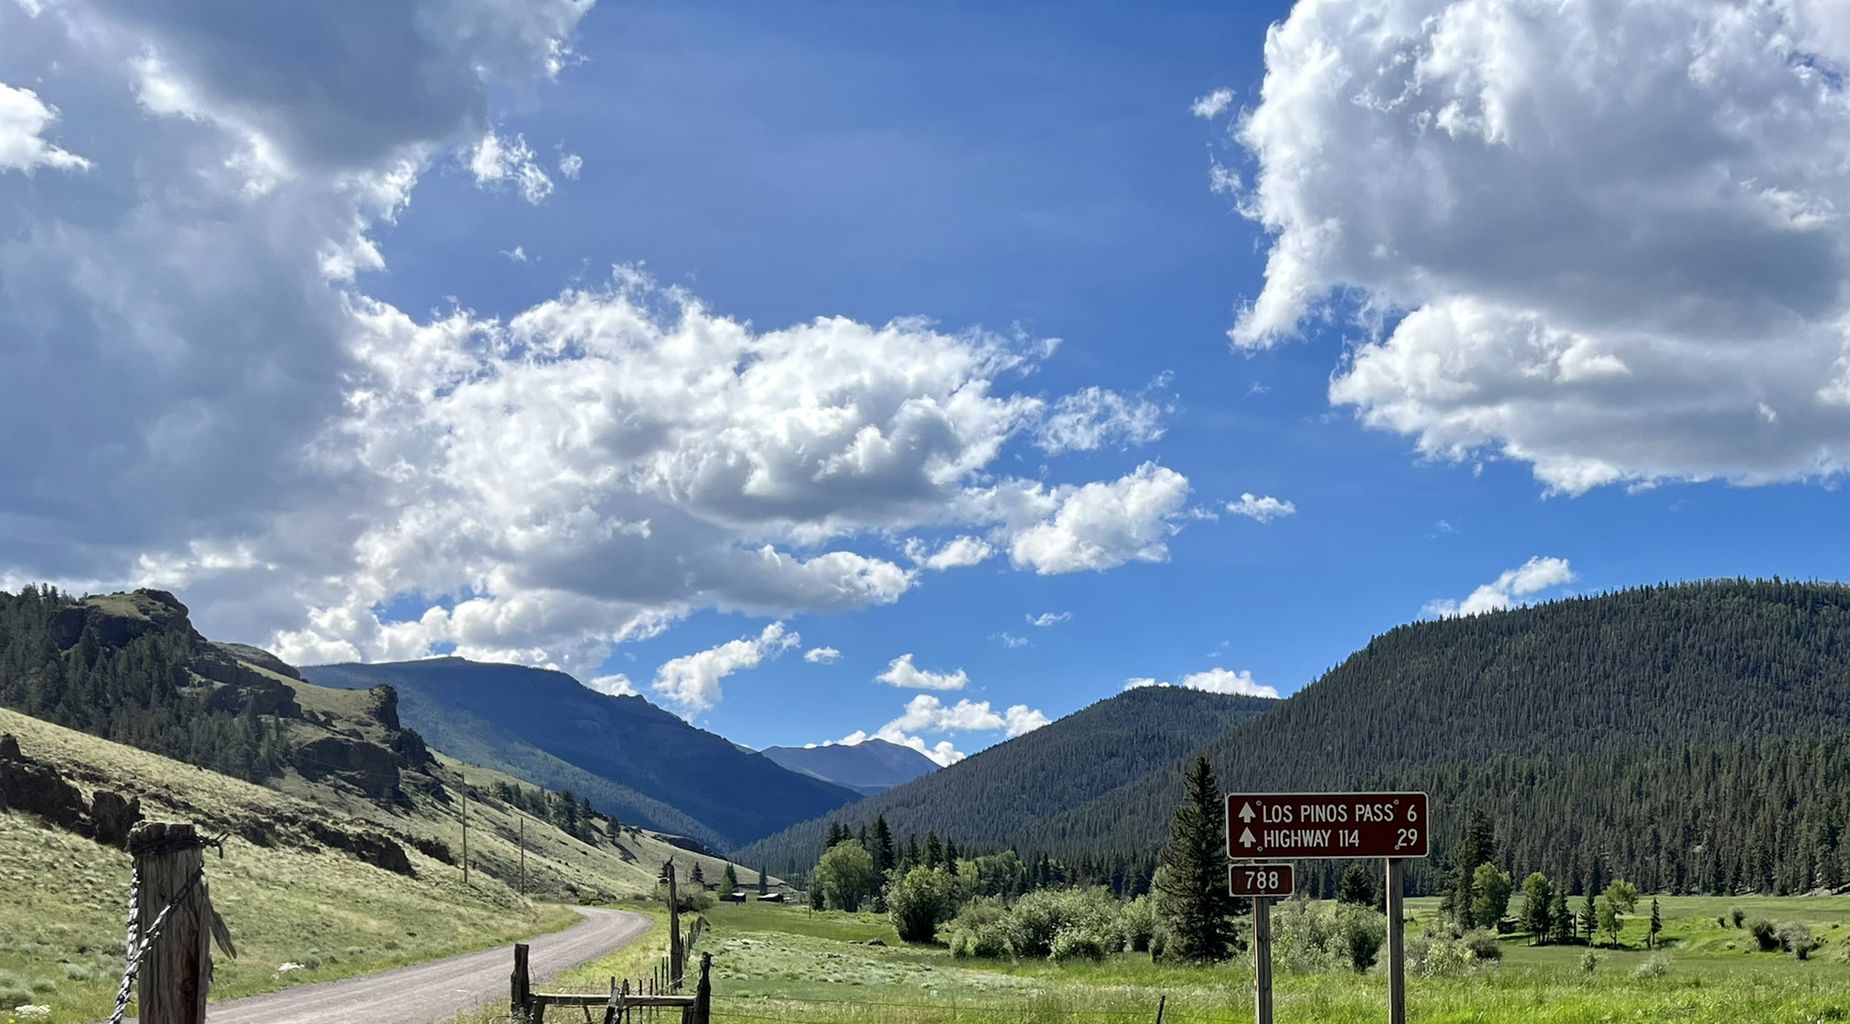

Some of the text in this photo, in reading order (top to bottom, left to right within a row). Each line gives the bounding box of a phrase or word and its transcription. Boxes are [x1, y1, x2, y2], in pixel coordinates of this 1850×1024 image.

[1263, 803, 1417, 823] LOS PINOS PASS 6
[1264, 828, 1418, 848] HIGHWAY 114 29
[1245, 871, 1279, 889] 788
